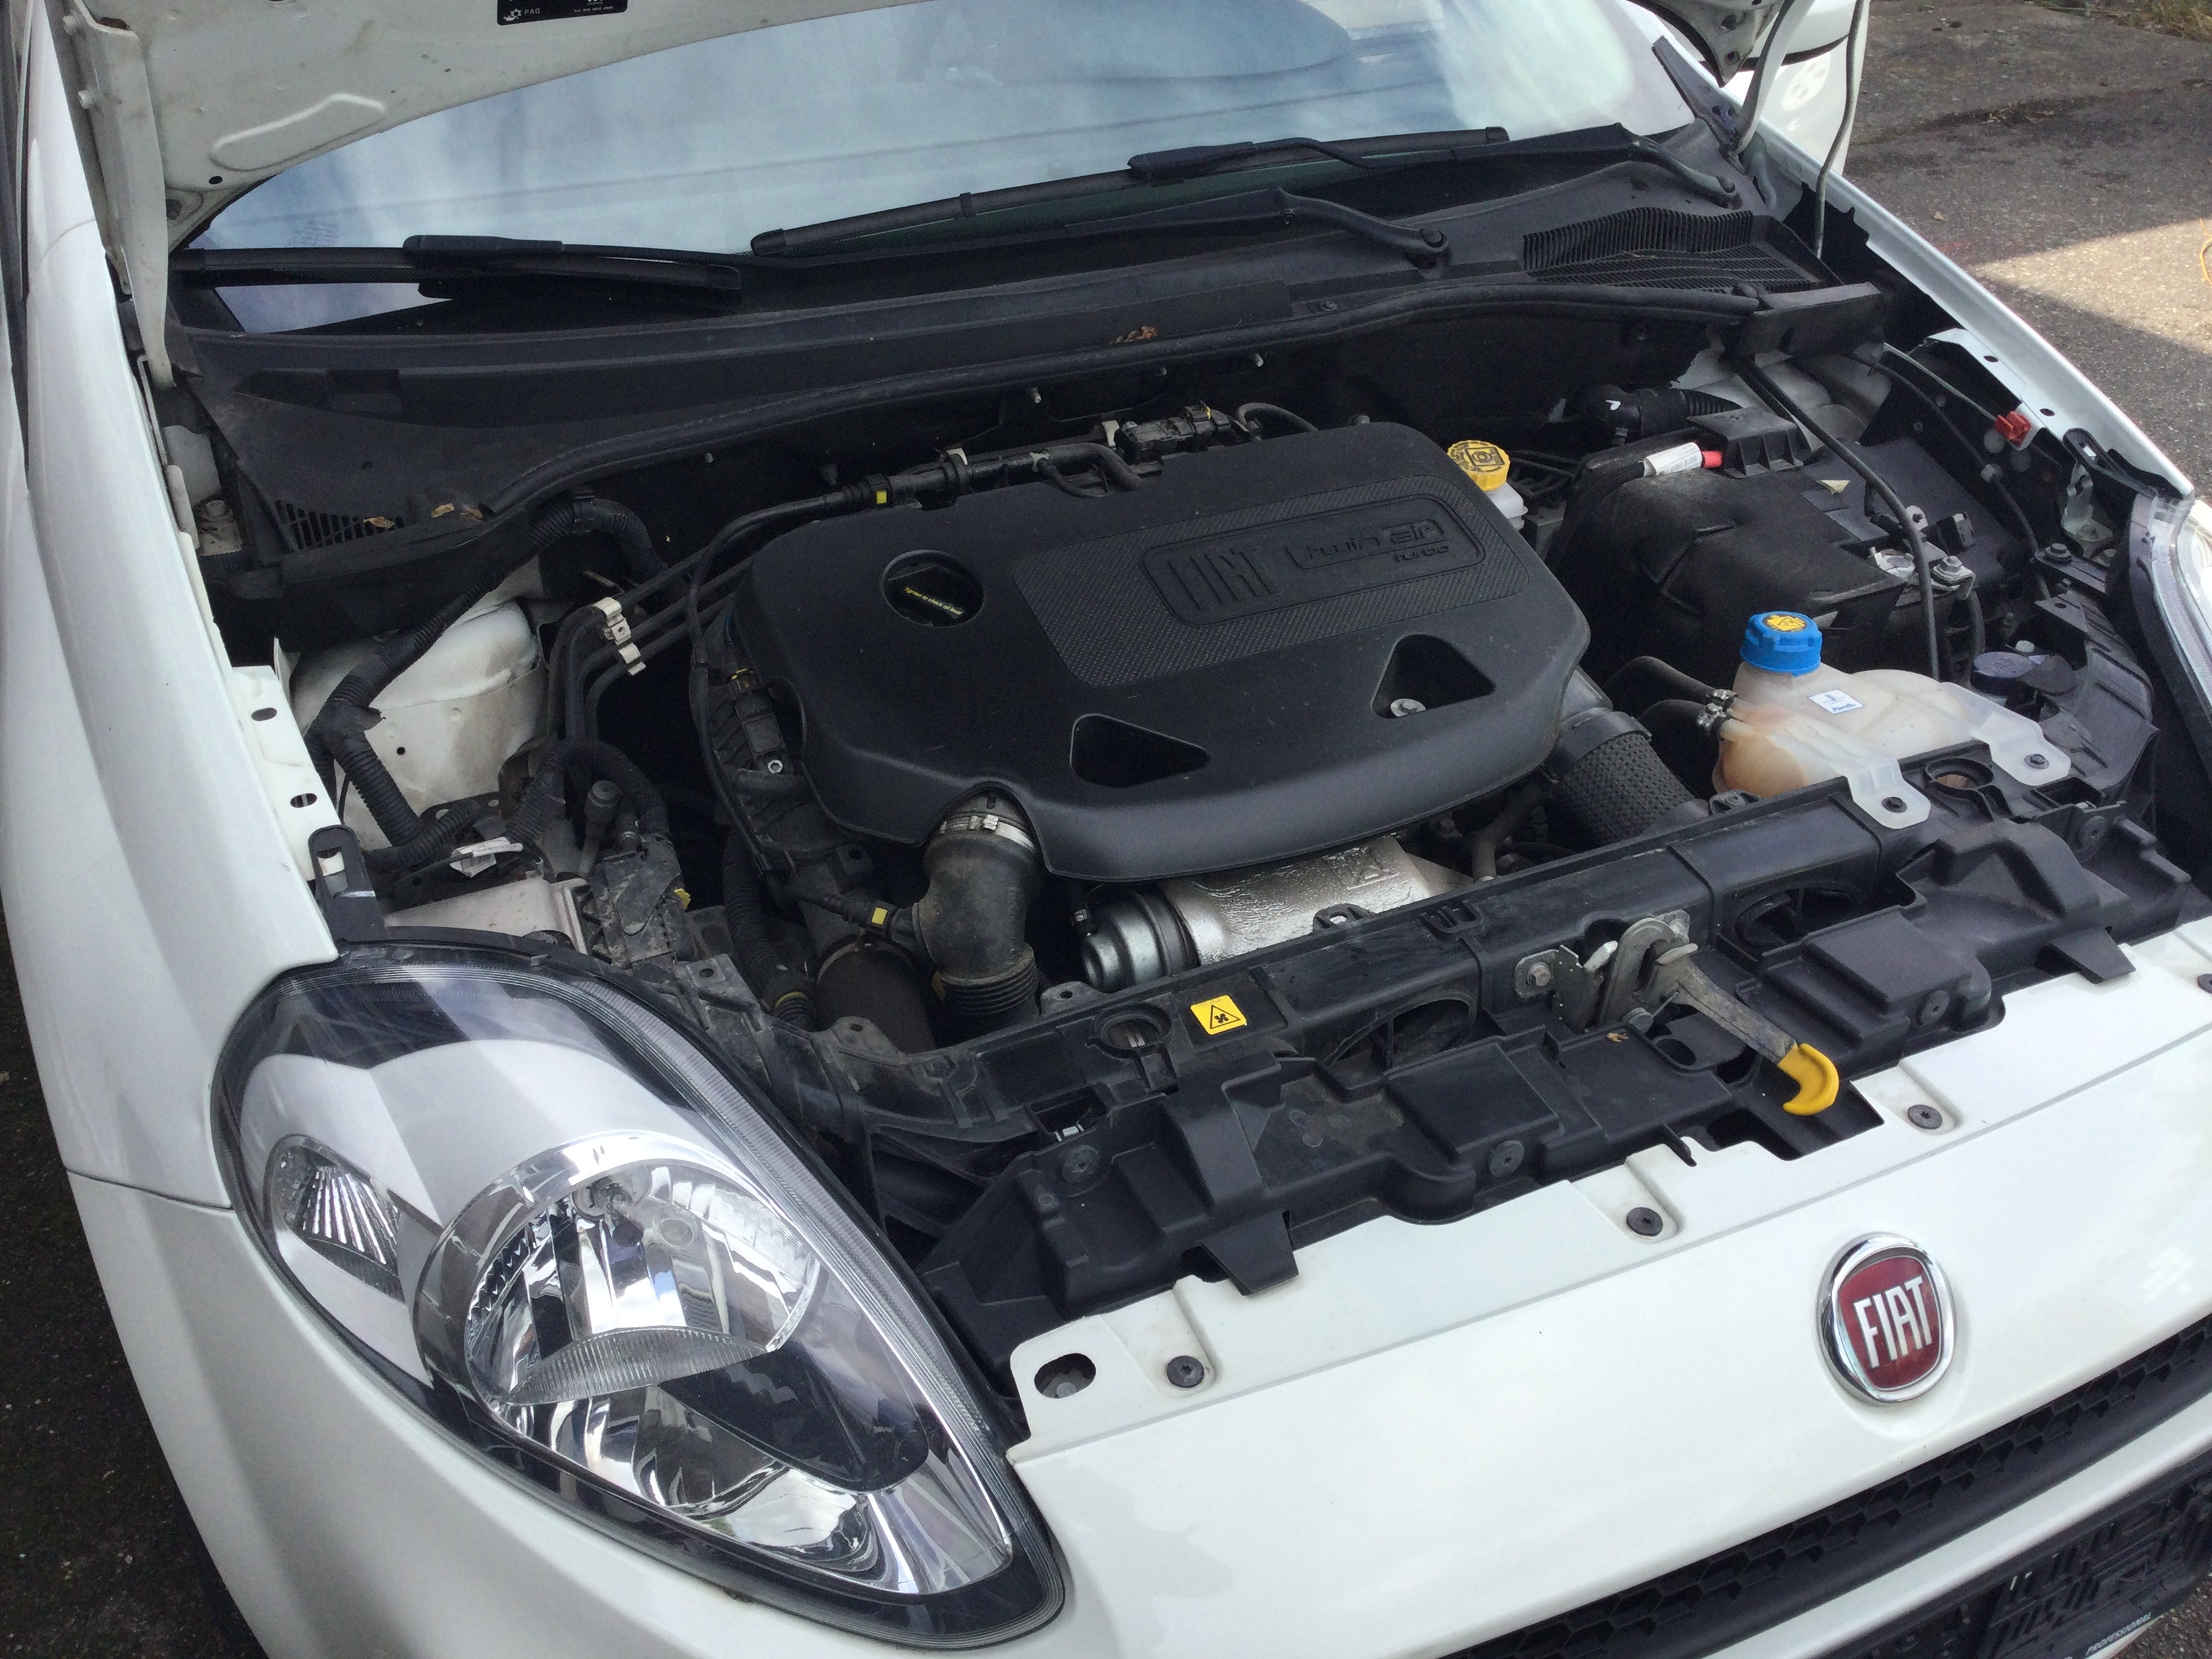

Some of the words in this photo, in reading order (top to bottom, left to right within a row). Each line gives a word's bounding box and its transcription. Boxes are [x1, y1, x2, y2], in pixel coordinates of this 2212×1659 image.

[1394, 545, 1449, 563] turbo
[1853, 1276, 1933, 1369] FIAT
[2085, 1612, 2152, 1656] PROFESSIONAL
